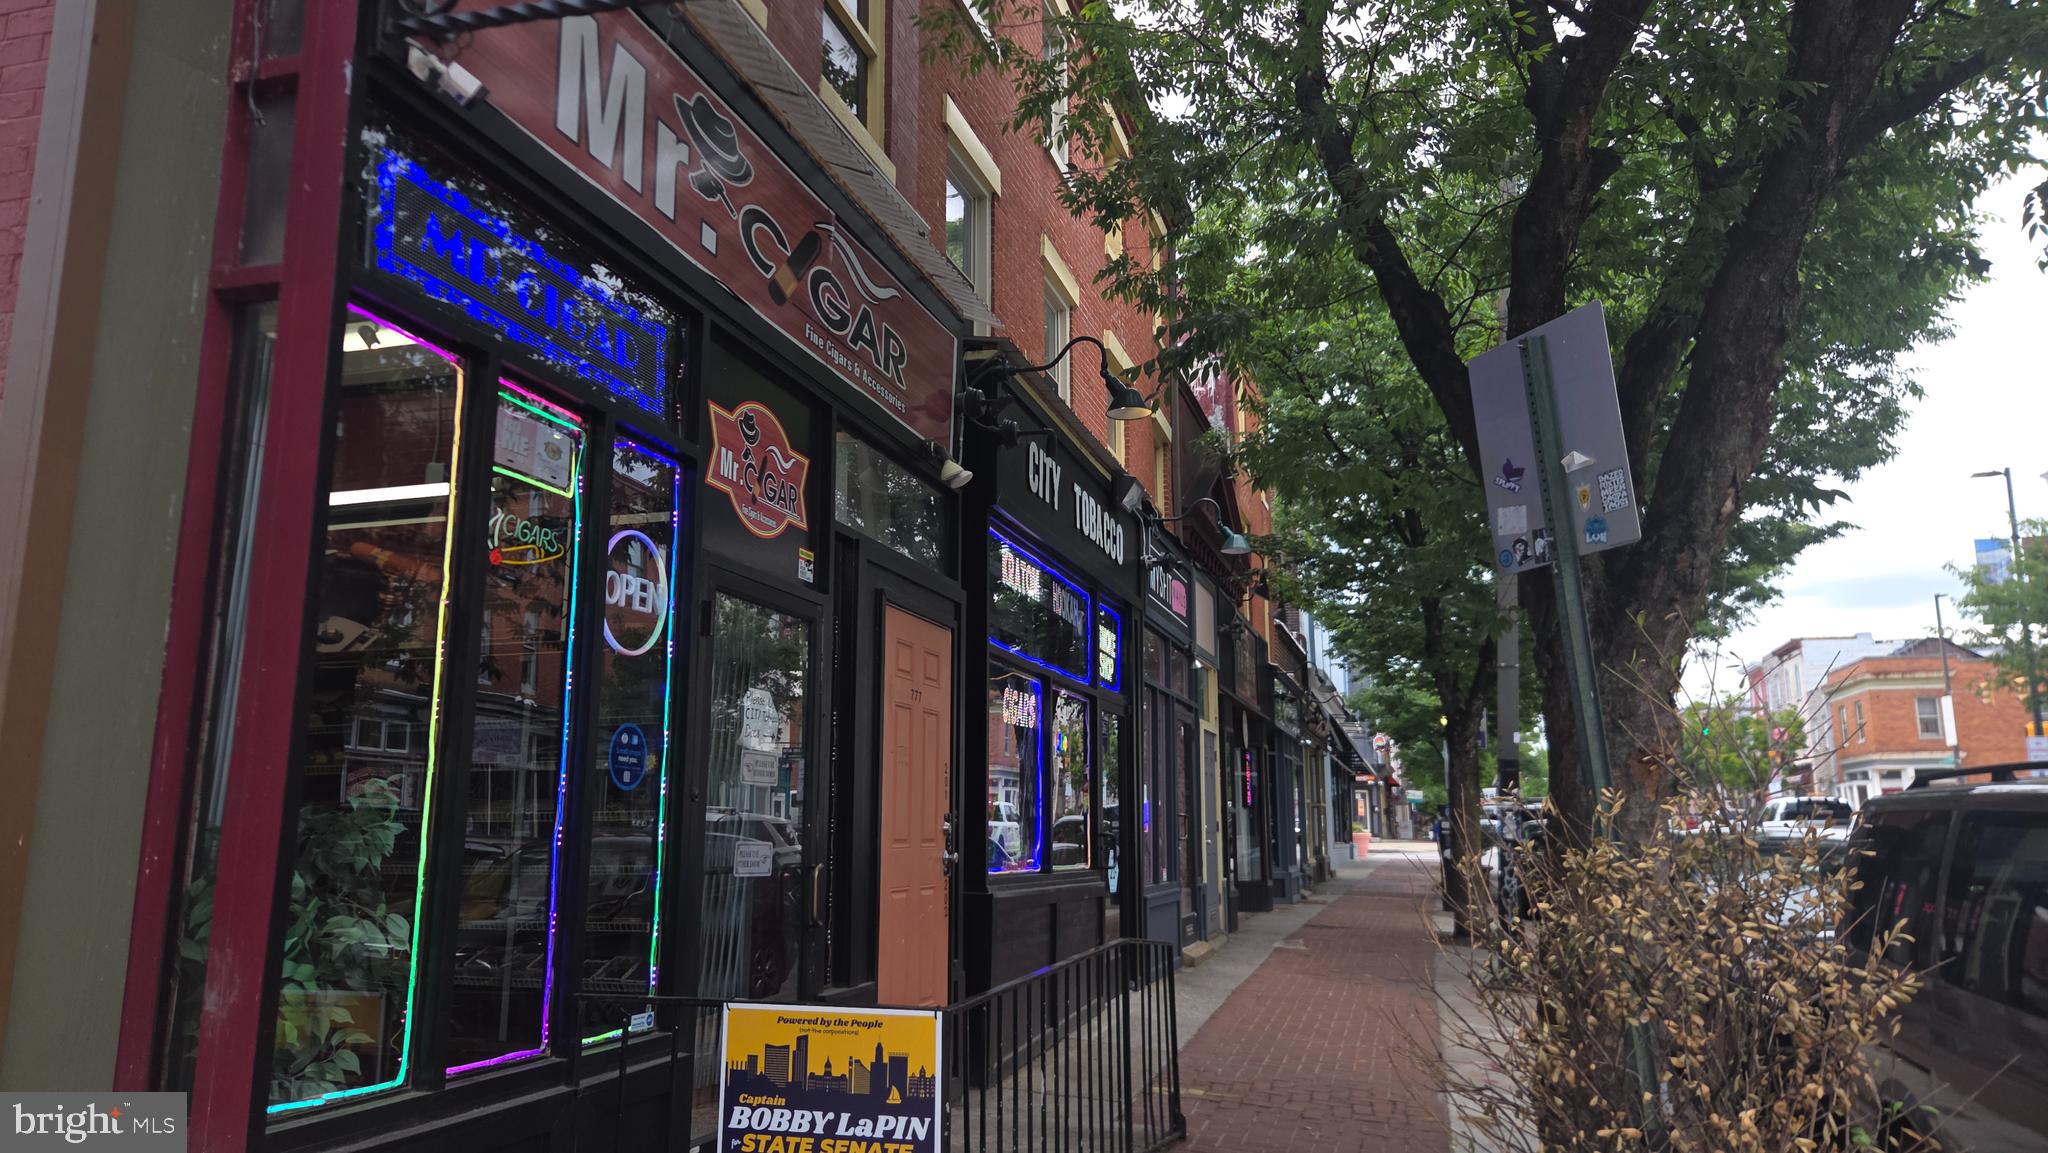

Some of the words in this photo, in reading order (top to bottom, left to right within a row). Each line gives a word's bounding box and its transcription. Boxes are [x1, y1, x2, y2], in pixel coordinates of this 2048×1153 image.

[555, 15, 717, 257] Mr.
[805, 323, 824, 350] Fine
[826, 341, 852, 371] Cigars
[854, 363, 860, 377] &
[862, 369, 906, 413] Accessories
[720, 446, 744, 486] Mr.
[1029, 441, 1061, 511] CITY
[1074, 482, 1124, 565] TOBACCO
[503, 514, 559, 553] CIGARS
[605, 570, 663, 615] OPEN
[1002, 687, 1036, 728] CIGARS
[777, 1016, 819, 1025] Powered
[820, 1017, 832, 1027] by
[833, 1018, 849, 1027] the
[851, 1019, 883, 1029] People
[739, 1093, 786, 1106] Captain
[728, 1105, 835, 1135] BOBBY
[834, 1112, 932, 1141] LaPIN
[741, 1133, 815, 1153] STATE
